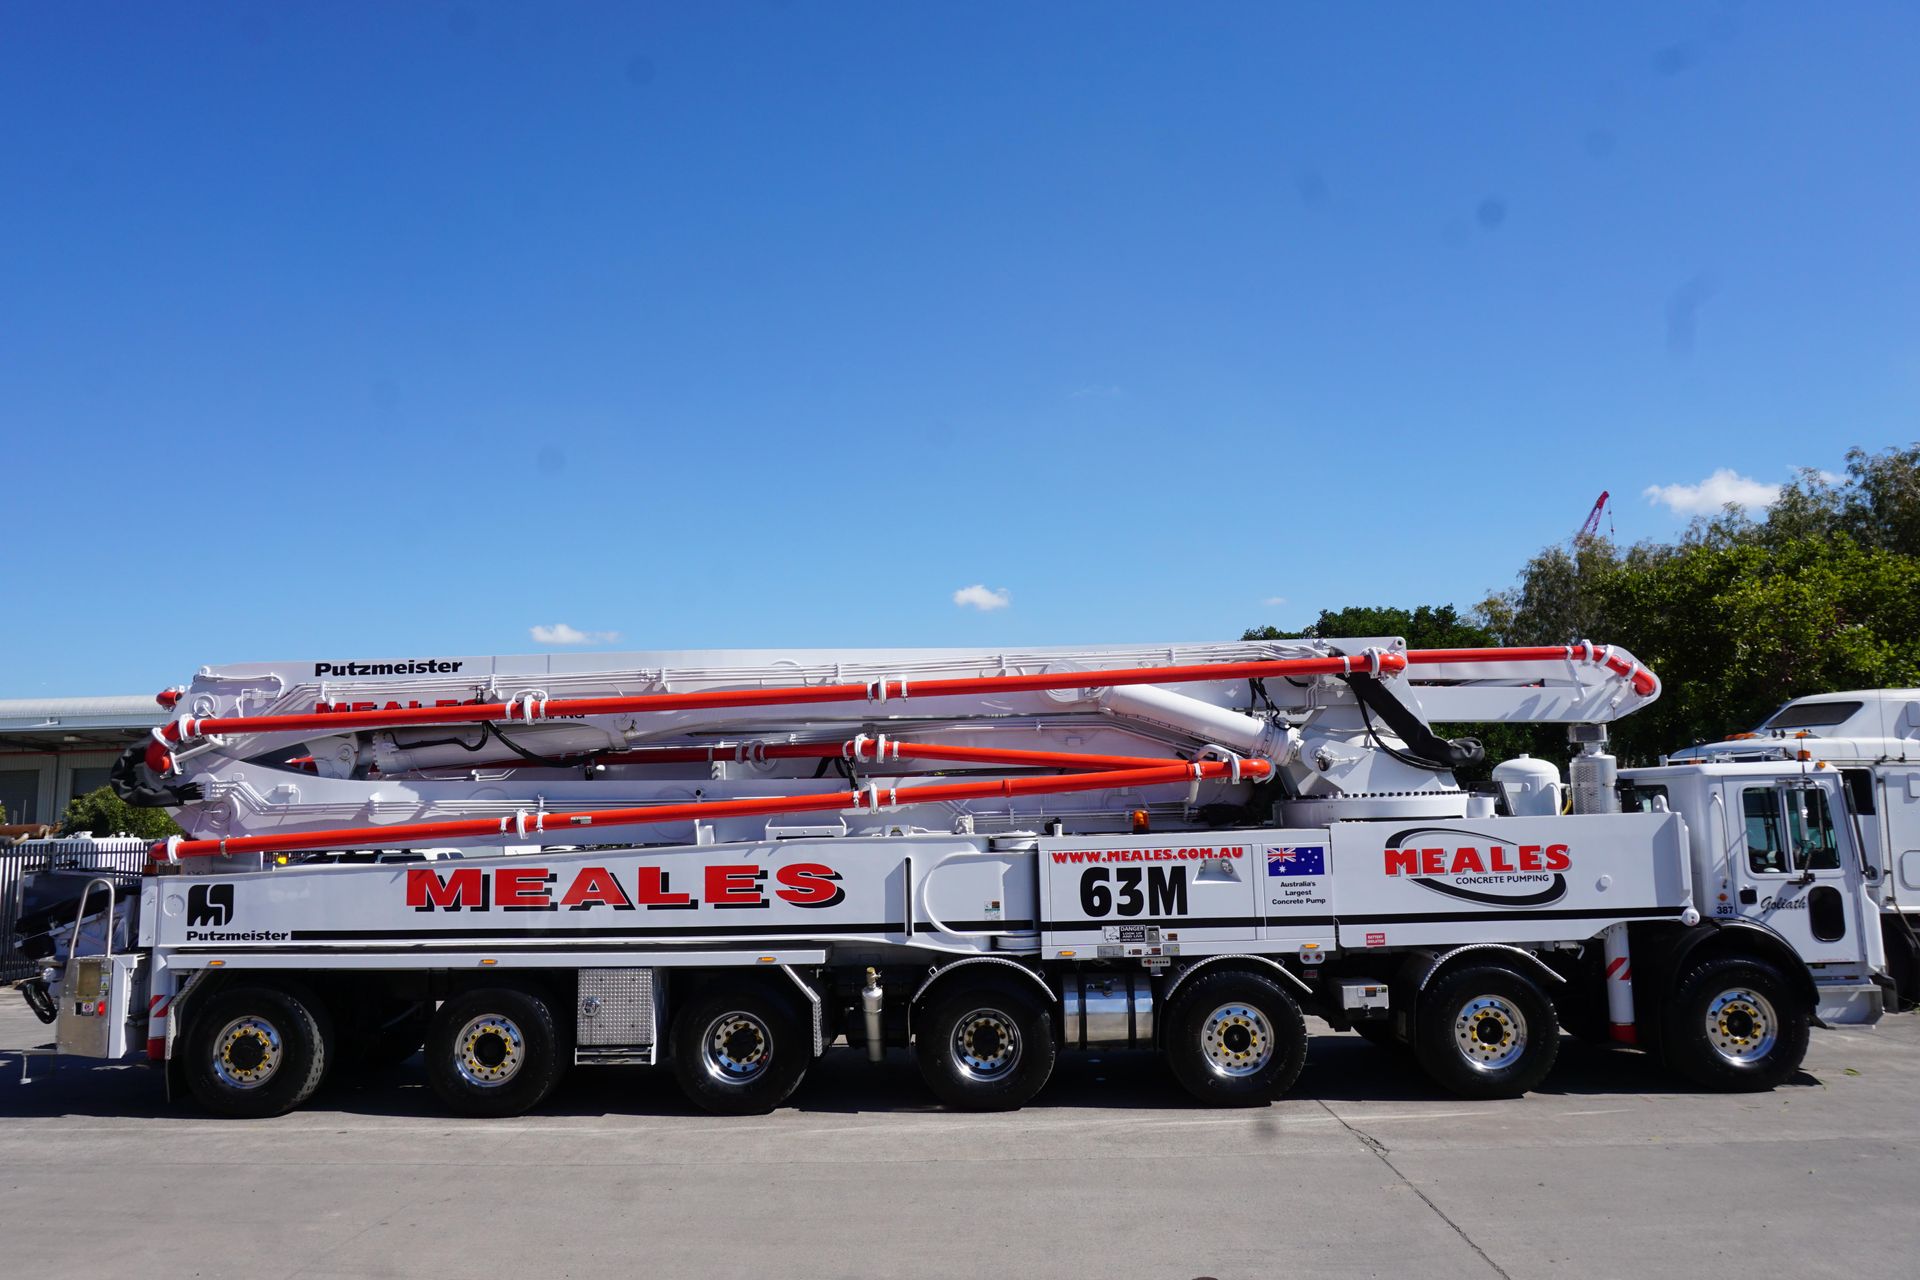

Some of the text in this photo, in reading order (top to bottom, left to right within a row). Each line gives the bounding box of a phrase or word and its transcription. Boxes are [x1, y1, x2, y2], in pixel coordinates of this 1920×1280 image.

[315, 660, 463, 677] Putzmeister
[1052, 847, 1244, 864] WWW.MEALES.COM.AU
[1384, 844, 1572, 877] MEALES
[406, 863, 846, 912] MEALES
[1455, 874, 1550, 885] CONCRETE PUMPING
[1079, 865, 1189, 918] 63M
[1716, 906, 1734, 914] 387
[1760, 895, 1806, 914] Goliath
[186, 930, 289, 941] Putzmeister
